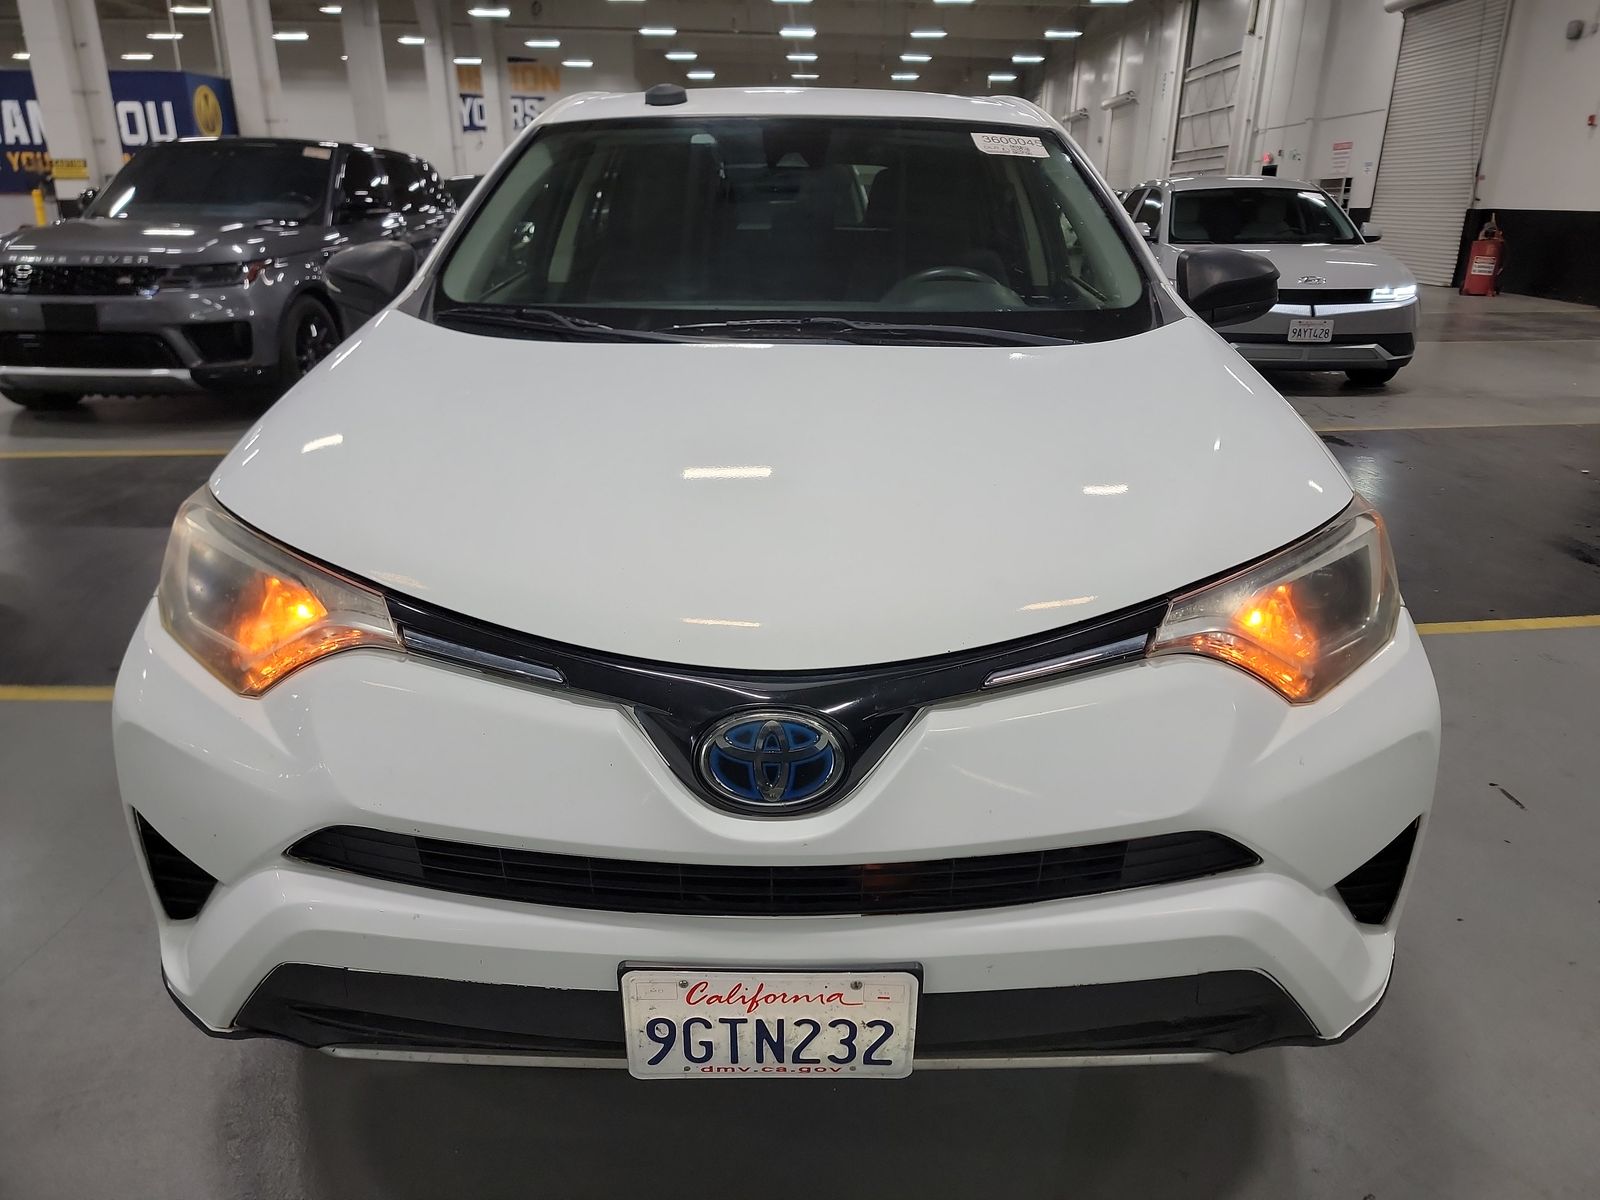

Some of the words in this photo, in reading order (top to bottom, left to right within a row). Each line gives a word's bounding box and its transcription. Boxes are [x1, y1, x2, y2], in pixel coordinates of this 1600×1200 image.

[116, 101, 178, 145] OU
[81, 255, 149, 264] ROVER
[1291, 328, 1330, 339] 9AYT428
[685, 980, 864, 1014] California
[645, 1016, 895, 1066] 9GTN232
[700, 1065, 842, 1073] dmv.ca.gov
